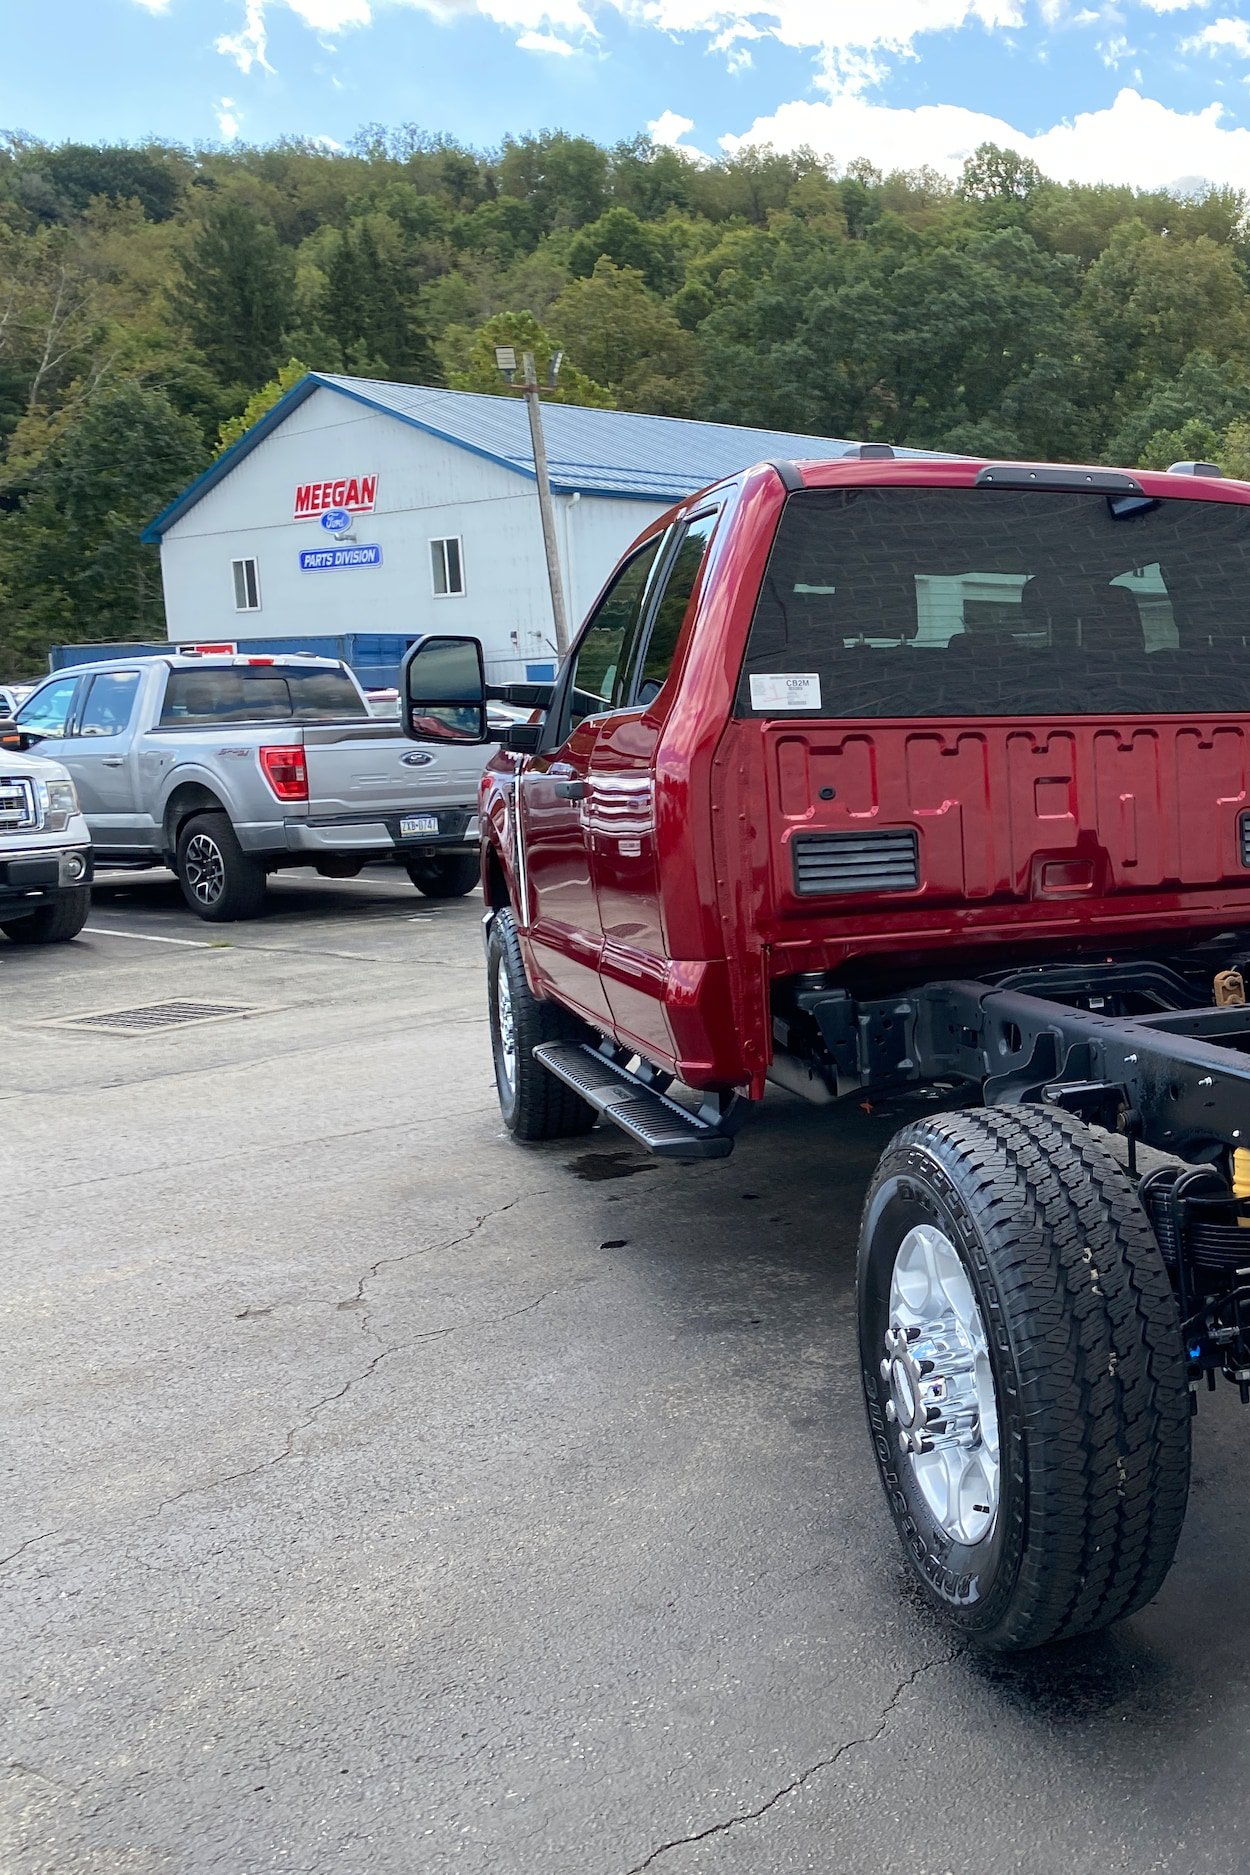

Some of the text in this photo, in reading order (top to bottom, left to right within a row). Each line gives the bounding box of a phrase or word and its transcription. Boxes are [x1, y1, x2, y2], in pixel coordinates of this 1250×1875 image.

[295, 476, 376, 512] MEEGAN
[304, 549, 376, 568] PARTS DIVISION
[786, 679, 810, 687] CB2M
[864, 1369, 973, 1599] BRIDGESTONE
